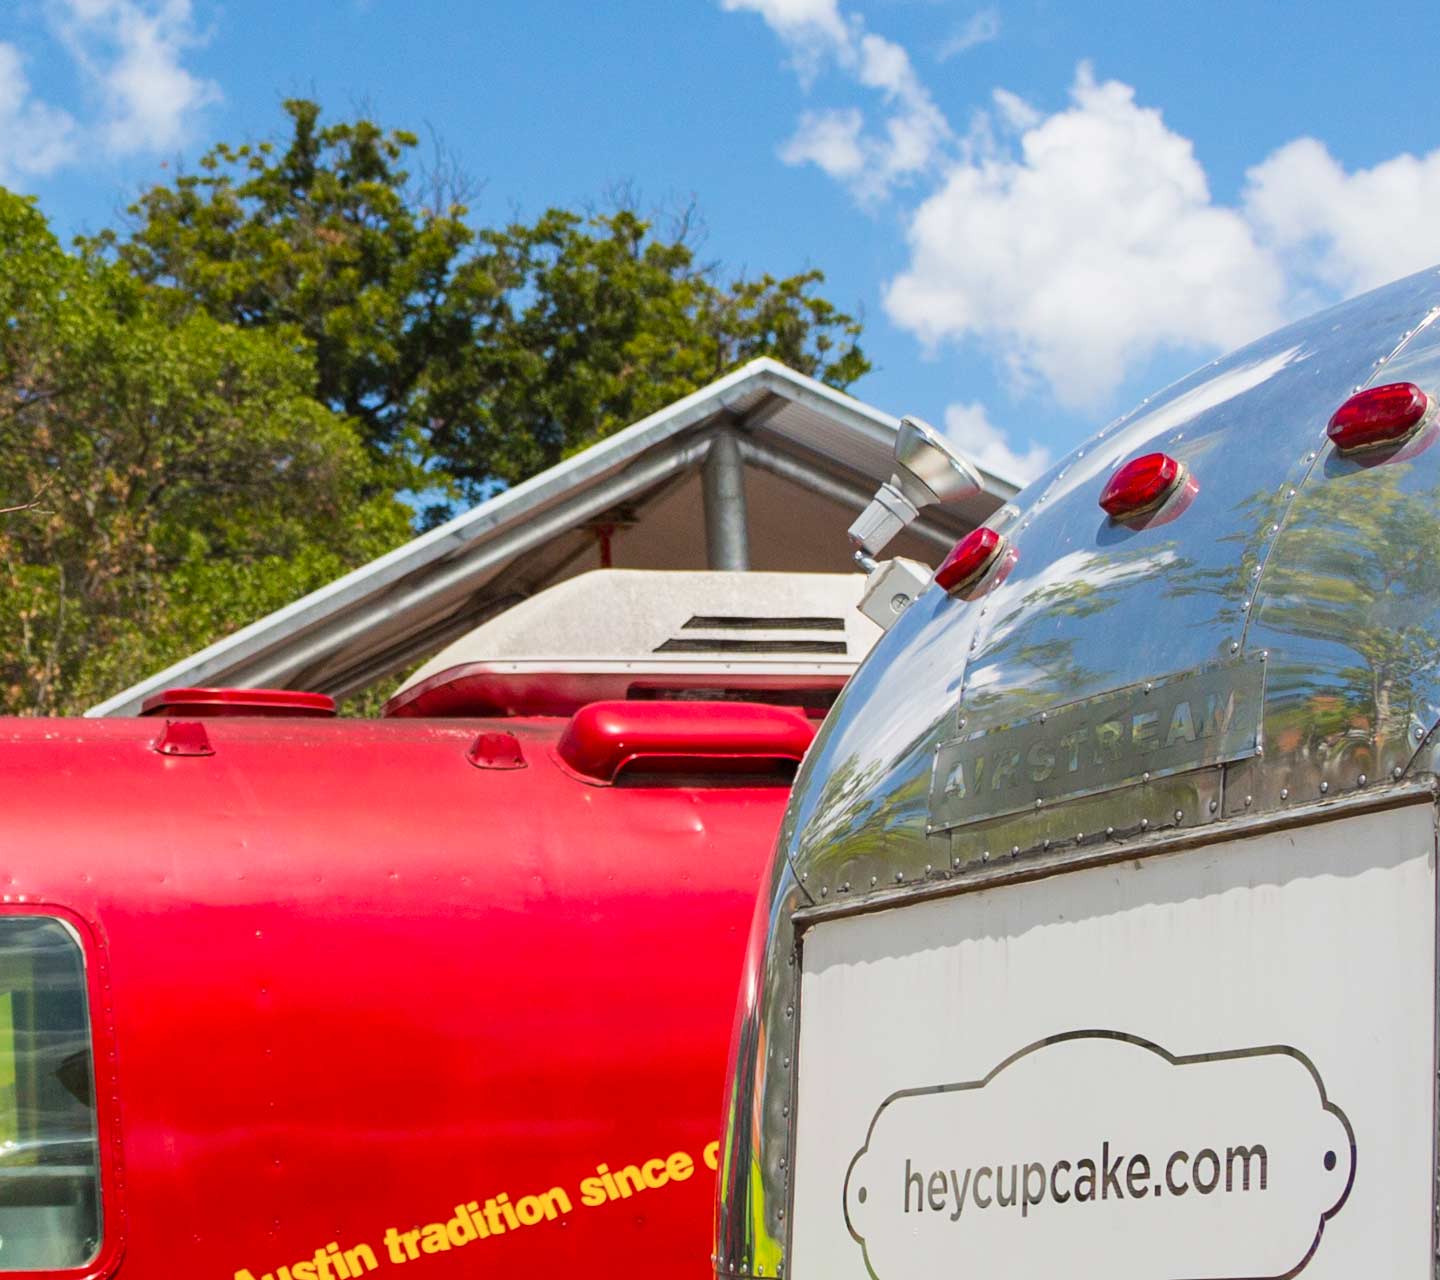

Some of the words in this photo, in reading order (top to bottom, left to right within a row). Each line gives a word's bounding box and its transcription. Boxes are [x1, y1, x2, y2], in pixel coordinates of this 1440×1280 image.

[942, 688, 1238, 800] AIRSTREAM
[383, 1191, 574, 1265] tradition
[580, 1150, 695, 1208] since
[904, 1140, 1269, 1222] heycupcake.com
